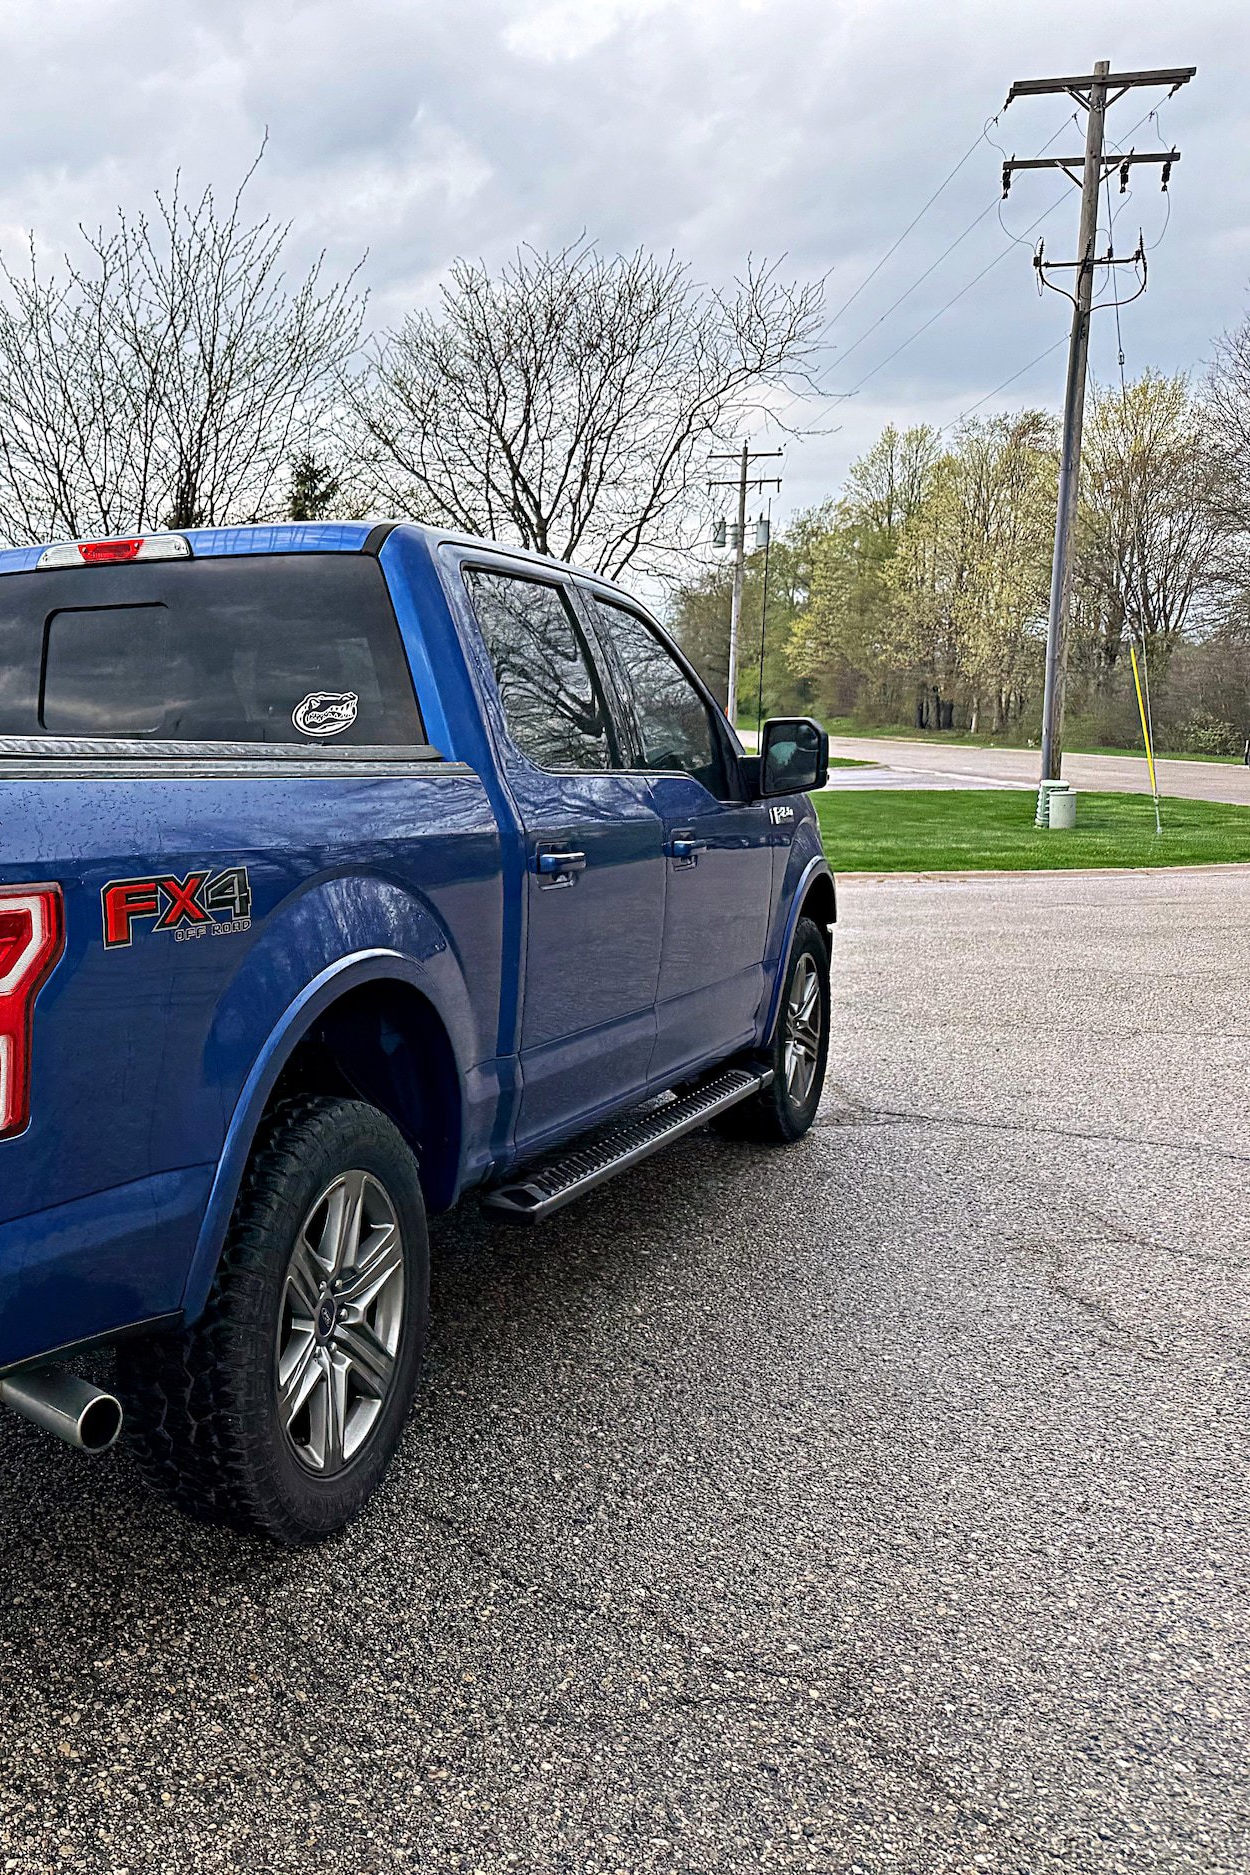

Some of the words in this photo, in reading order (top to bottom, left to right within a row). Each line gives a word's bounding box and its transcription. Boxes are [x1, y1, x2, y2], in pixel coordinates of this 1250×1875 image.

[100, 866, 252, 950] FX4
[175, 925, 207, 942] OFF
[211, 919, 252, 936] ROAD
